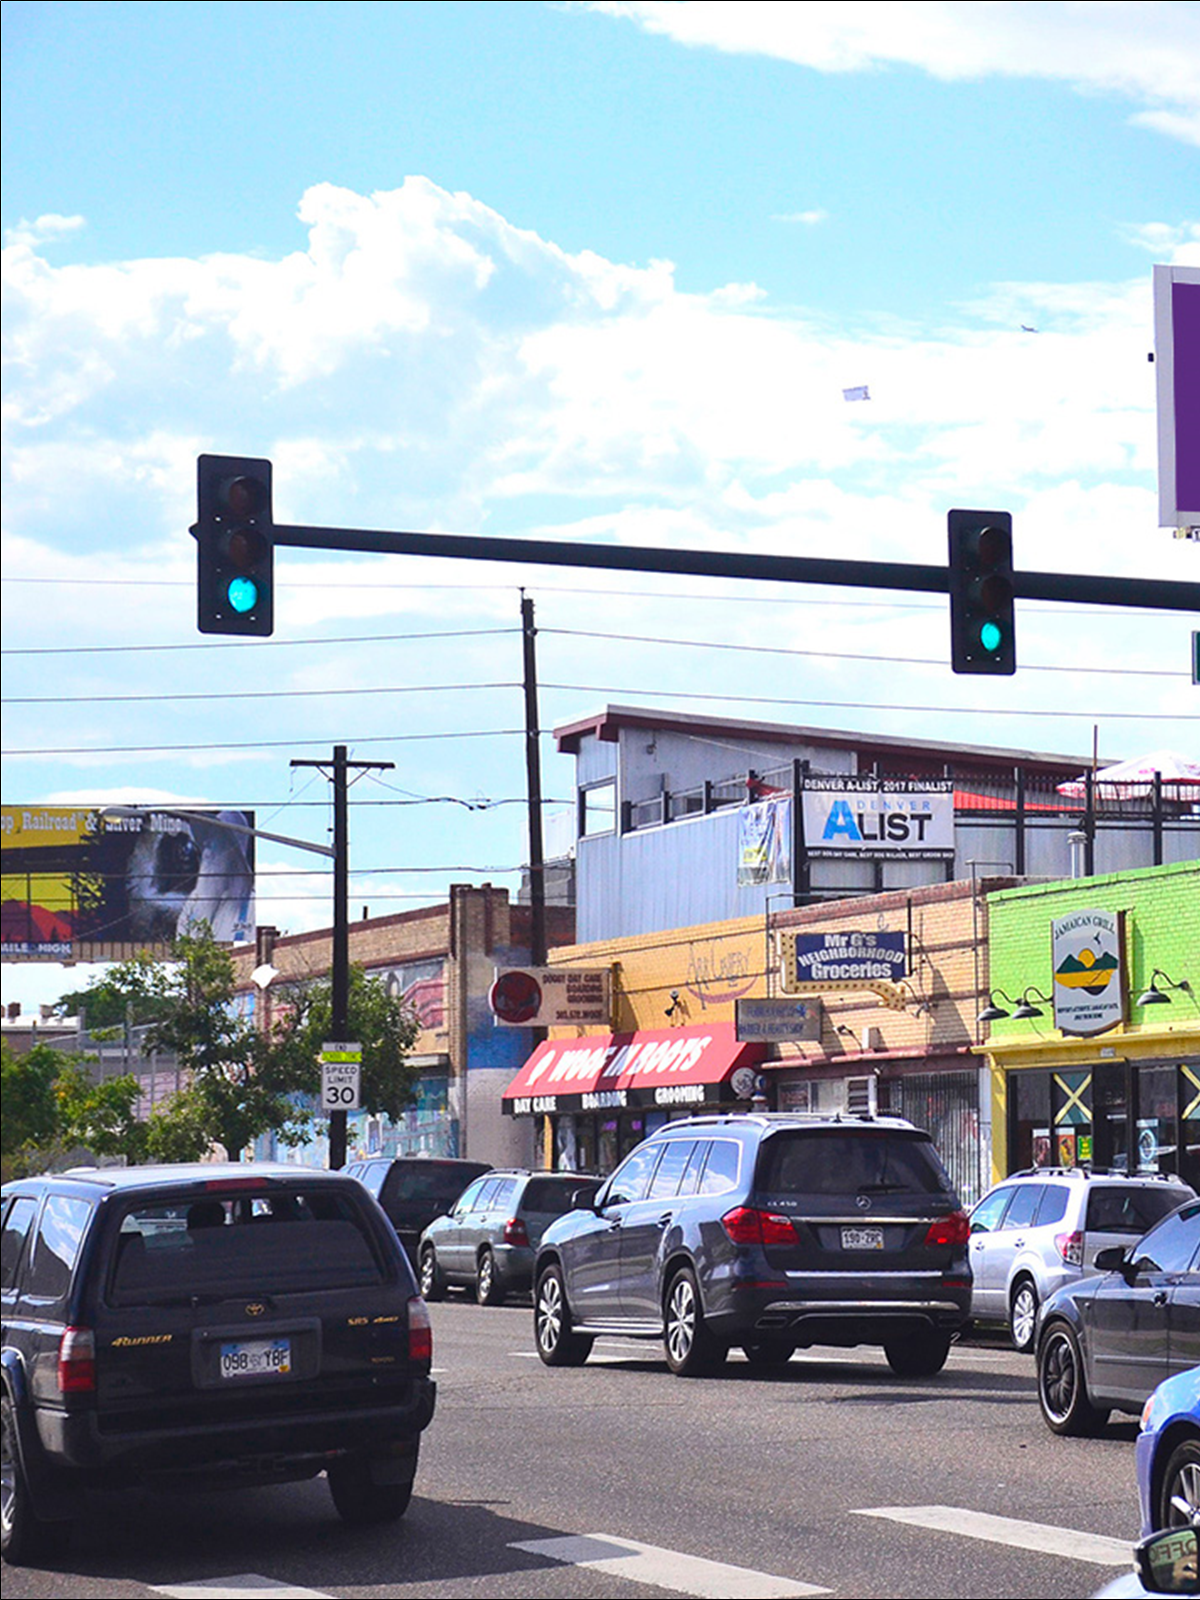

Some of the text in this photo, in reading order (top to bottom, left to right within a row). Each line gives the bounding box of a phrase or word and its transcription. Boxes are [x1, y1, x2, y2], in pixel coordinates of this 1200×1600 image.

[804, 780, 954, 791] DENVER A-LIST 2017 FINALIST
[857, 801, 931, 811] DENVER
[22, 812, 77, 831] Railroad
[85, 812, 97, 831] &
[1055, 915, 1115, 940] JAMAICAN GRILL
[824, 933, 877, 947] Mr G's
[798, 948, 905, 968] NEIGHBORHOOD
[567, 974, 581, 983] DAY
[584, 974, 602, 983] CARE
[811, 961, 893, 980] Groceries
[566, 984, 603, 993] BOARDING
[548, 1046, 618, 1082] WOOF
[602, 1043, 643, 1078] IN
[626, 1036, 713, 1076] BOOTS
[325, 1066, 357, 1075] SPEED
[327, 1086, 354, 1104] 30
[582, 1090, 627, 1109] BOARDING
[655, 1085, 705, 1104] GROOMING
[514, 1096, 557, 1113] DAY CARE
[224, 1353, 248, 1371] 098
